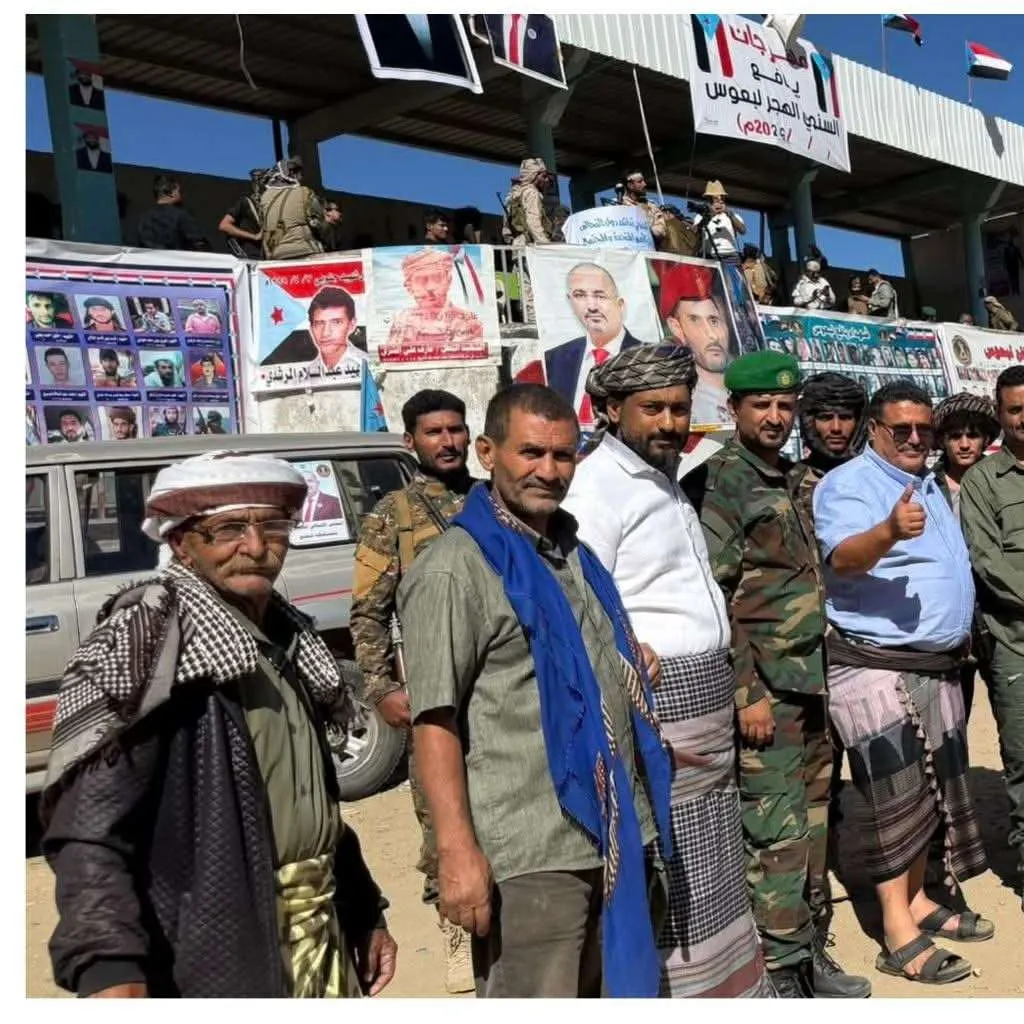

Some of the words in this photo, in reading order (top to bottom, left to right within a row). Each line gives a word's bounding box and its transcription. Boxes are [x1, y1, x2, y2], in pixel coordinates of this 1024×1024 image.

[729, 23, 809, 69] مهرجان
[705, 81, 762, 110] لبعوس
[751, 62, 801, 98] يافع
[767, 95, 800, 120] الهجر
